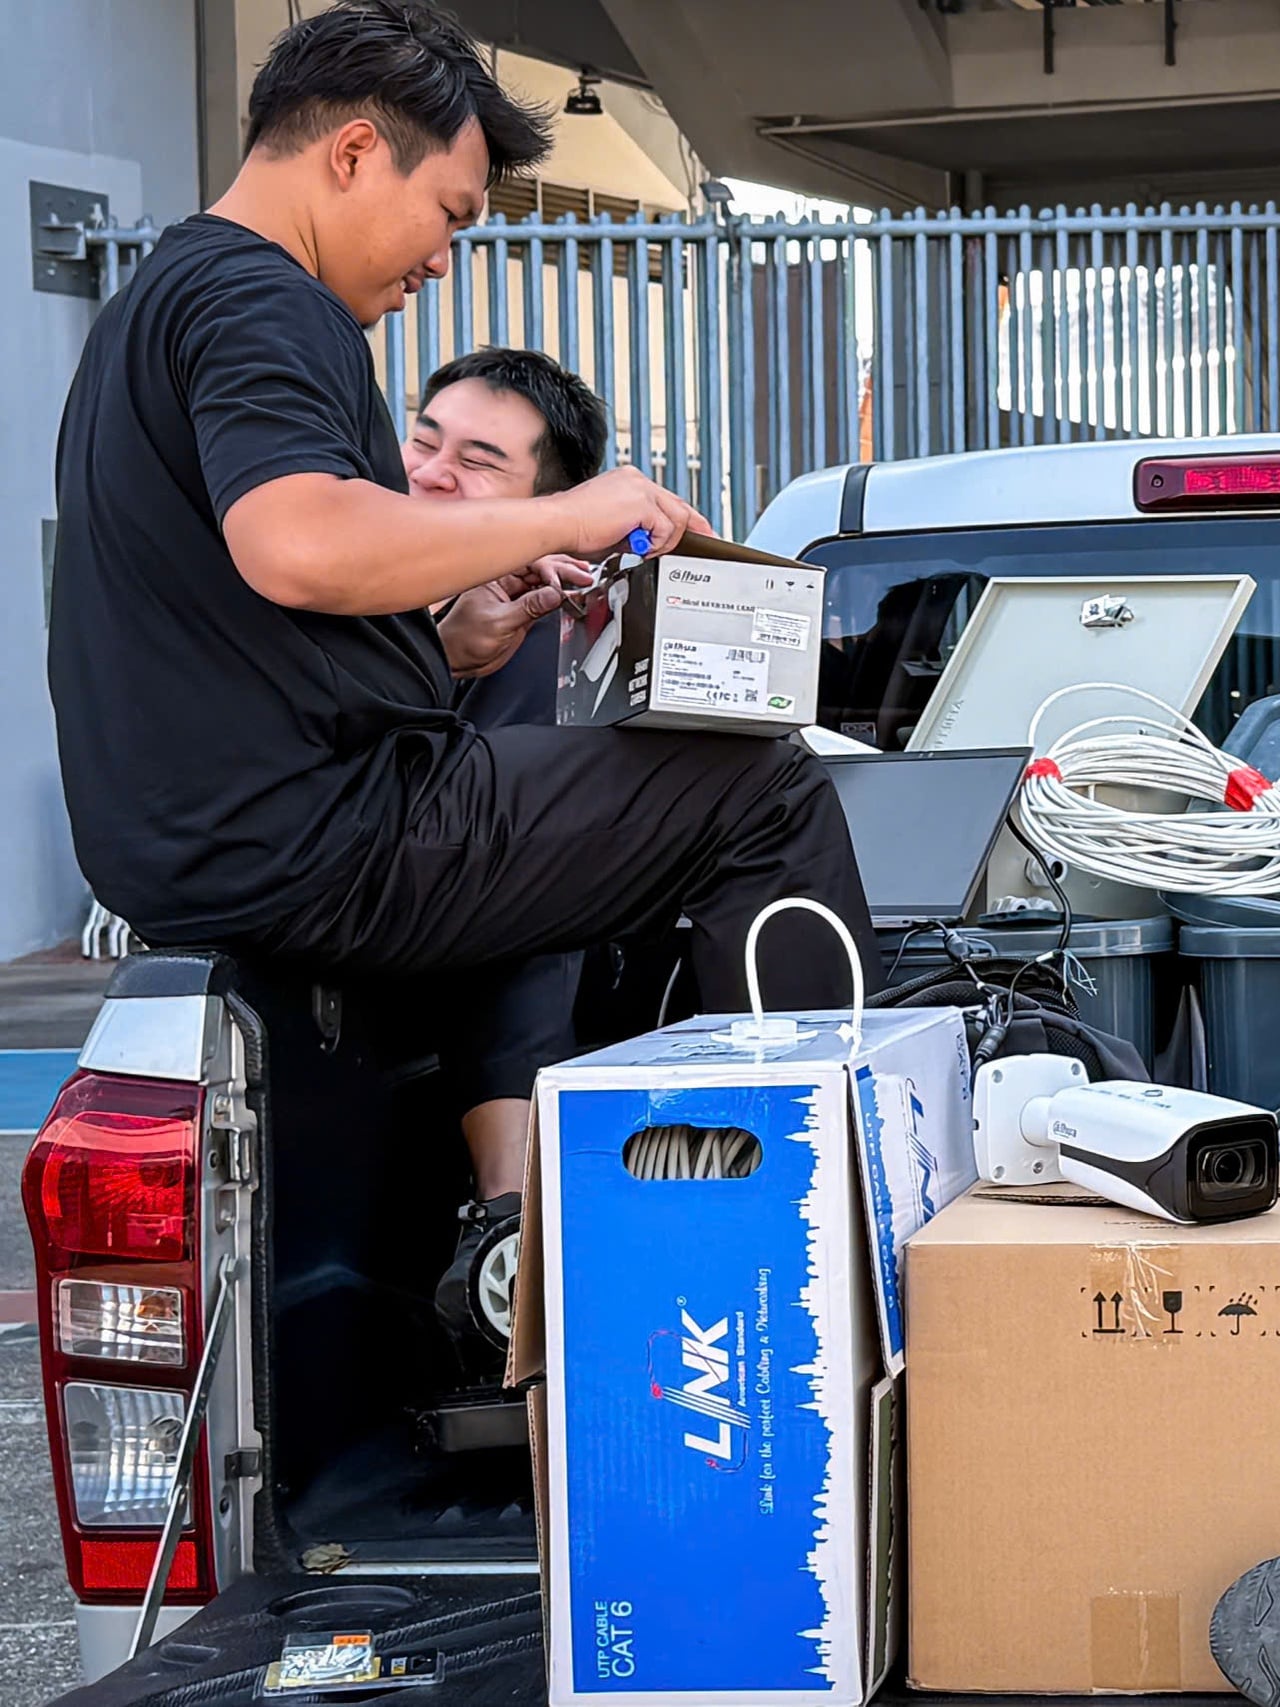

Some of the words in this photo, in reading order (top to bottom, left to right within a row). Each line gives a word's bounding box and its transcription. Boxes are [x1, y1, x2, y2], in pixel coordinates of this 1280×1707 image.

[865, 1112, 876, 1157] UTP
[735, 1311, 745, 1356] Standard
[663, 1309, 751, 1460] LINK
[737, 1360, 746, 1407] American
[755, 1348, 773, 1395] Cabling
[757, 1399, 775, 1437] perfect
[595, 1601, 609, 1647] CABLE
[610, 1601, 633, 1617] 6
[598, 1649, 610, 1678] UTP
[610, 1624, 635, 1677] CAT
